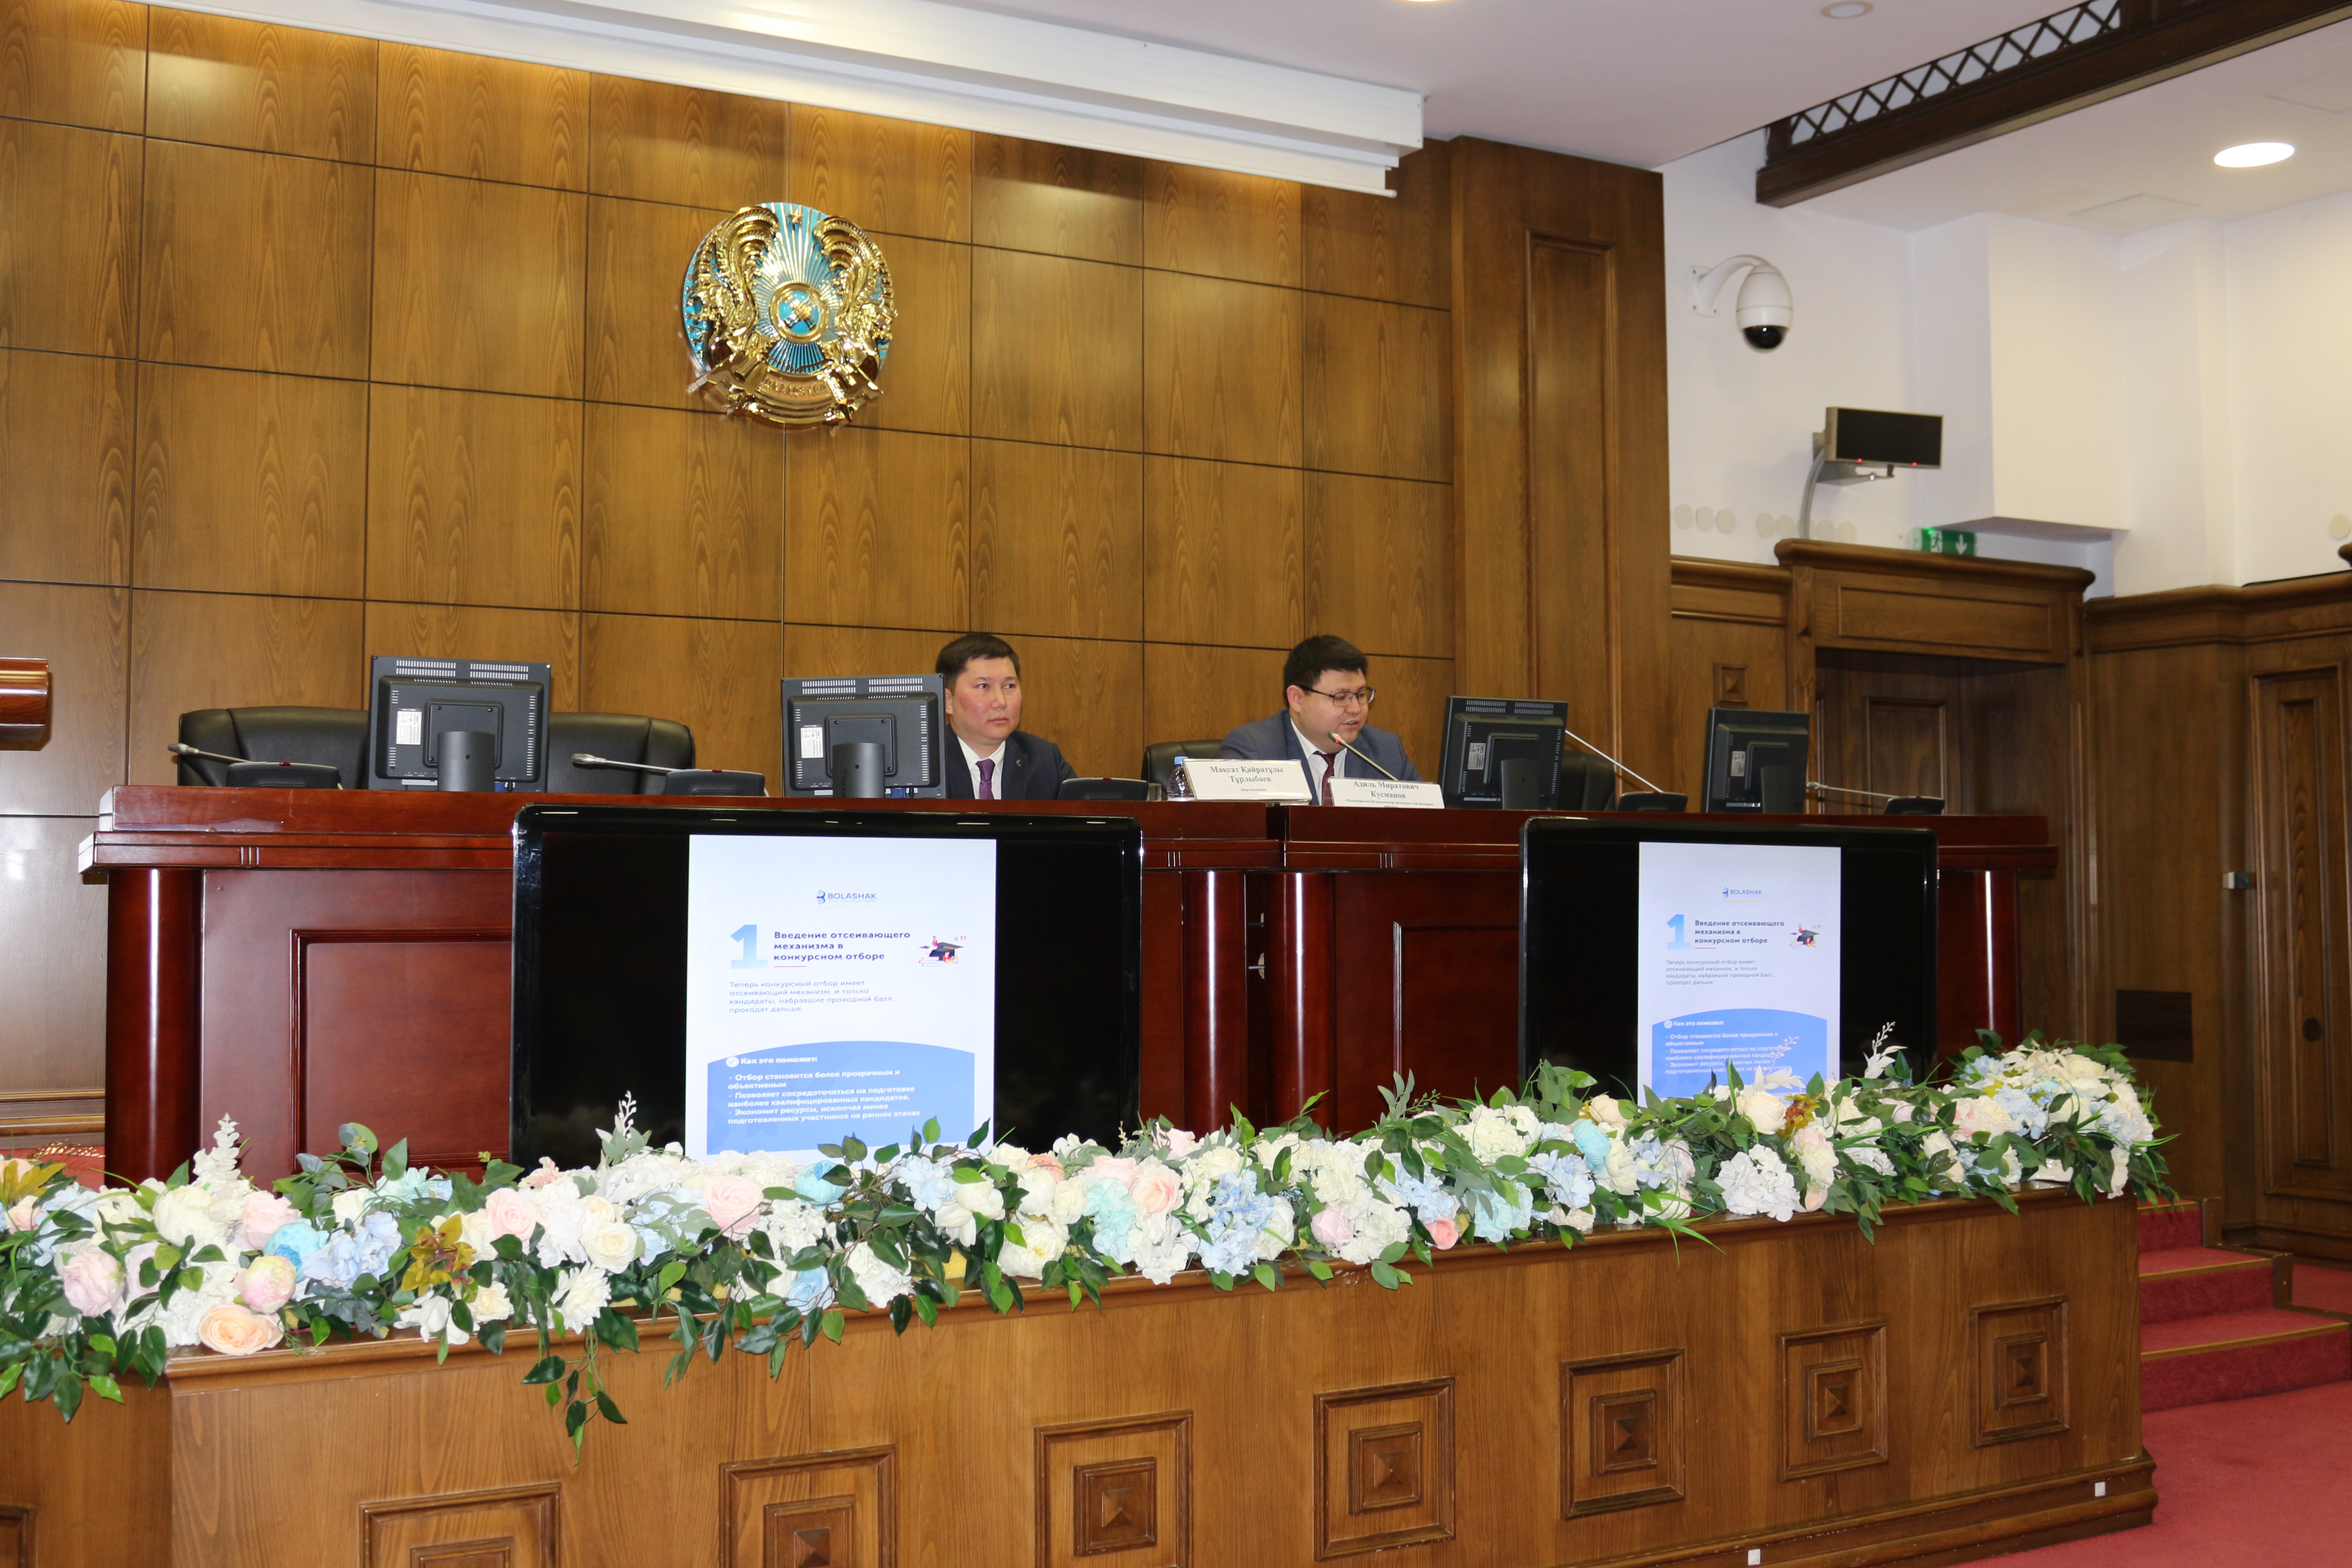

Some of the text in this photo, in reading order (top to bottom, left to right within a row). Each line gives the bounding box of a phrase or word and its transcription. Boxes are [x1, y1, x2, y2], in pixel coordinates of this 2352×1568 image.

[1241, 765, 1284, 774] Қайратұлы
[1229, 775, 1272, 784] Тұрлыбаев
[1378, 781, 1419, 790] Миратович
[1371, 790, 1406, 799] Кусманов
[774, 931, 827, 940] Введение
[1666, 914, 1691, 950] 1
[730, 924, 768, 969] 1
[846, 952, 884, 961] отборе
[782, 1089, 854, 1098] сосредоточиться
[771, 1097, 858, 1106] квалифицированных
[728, 1116, 799, 1124] подготовленных
[800, 1113, 848, 1122] участников
